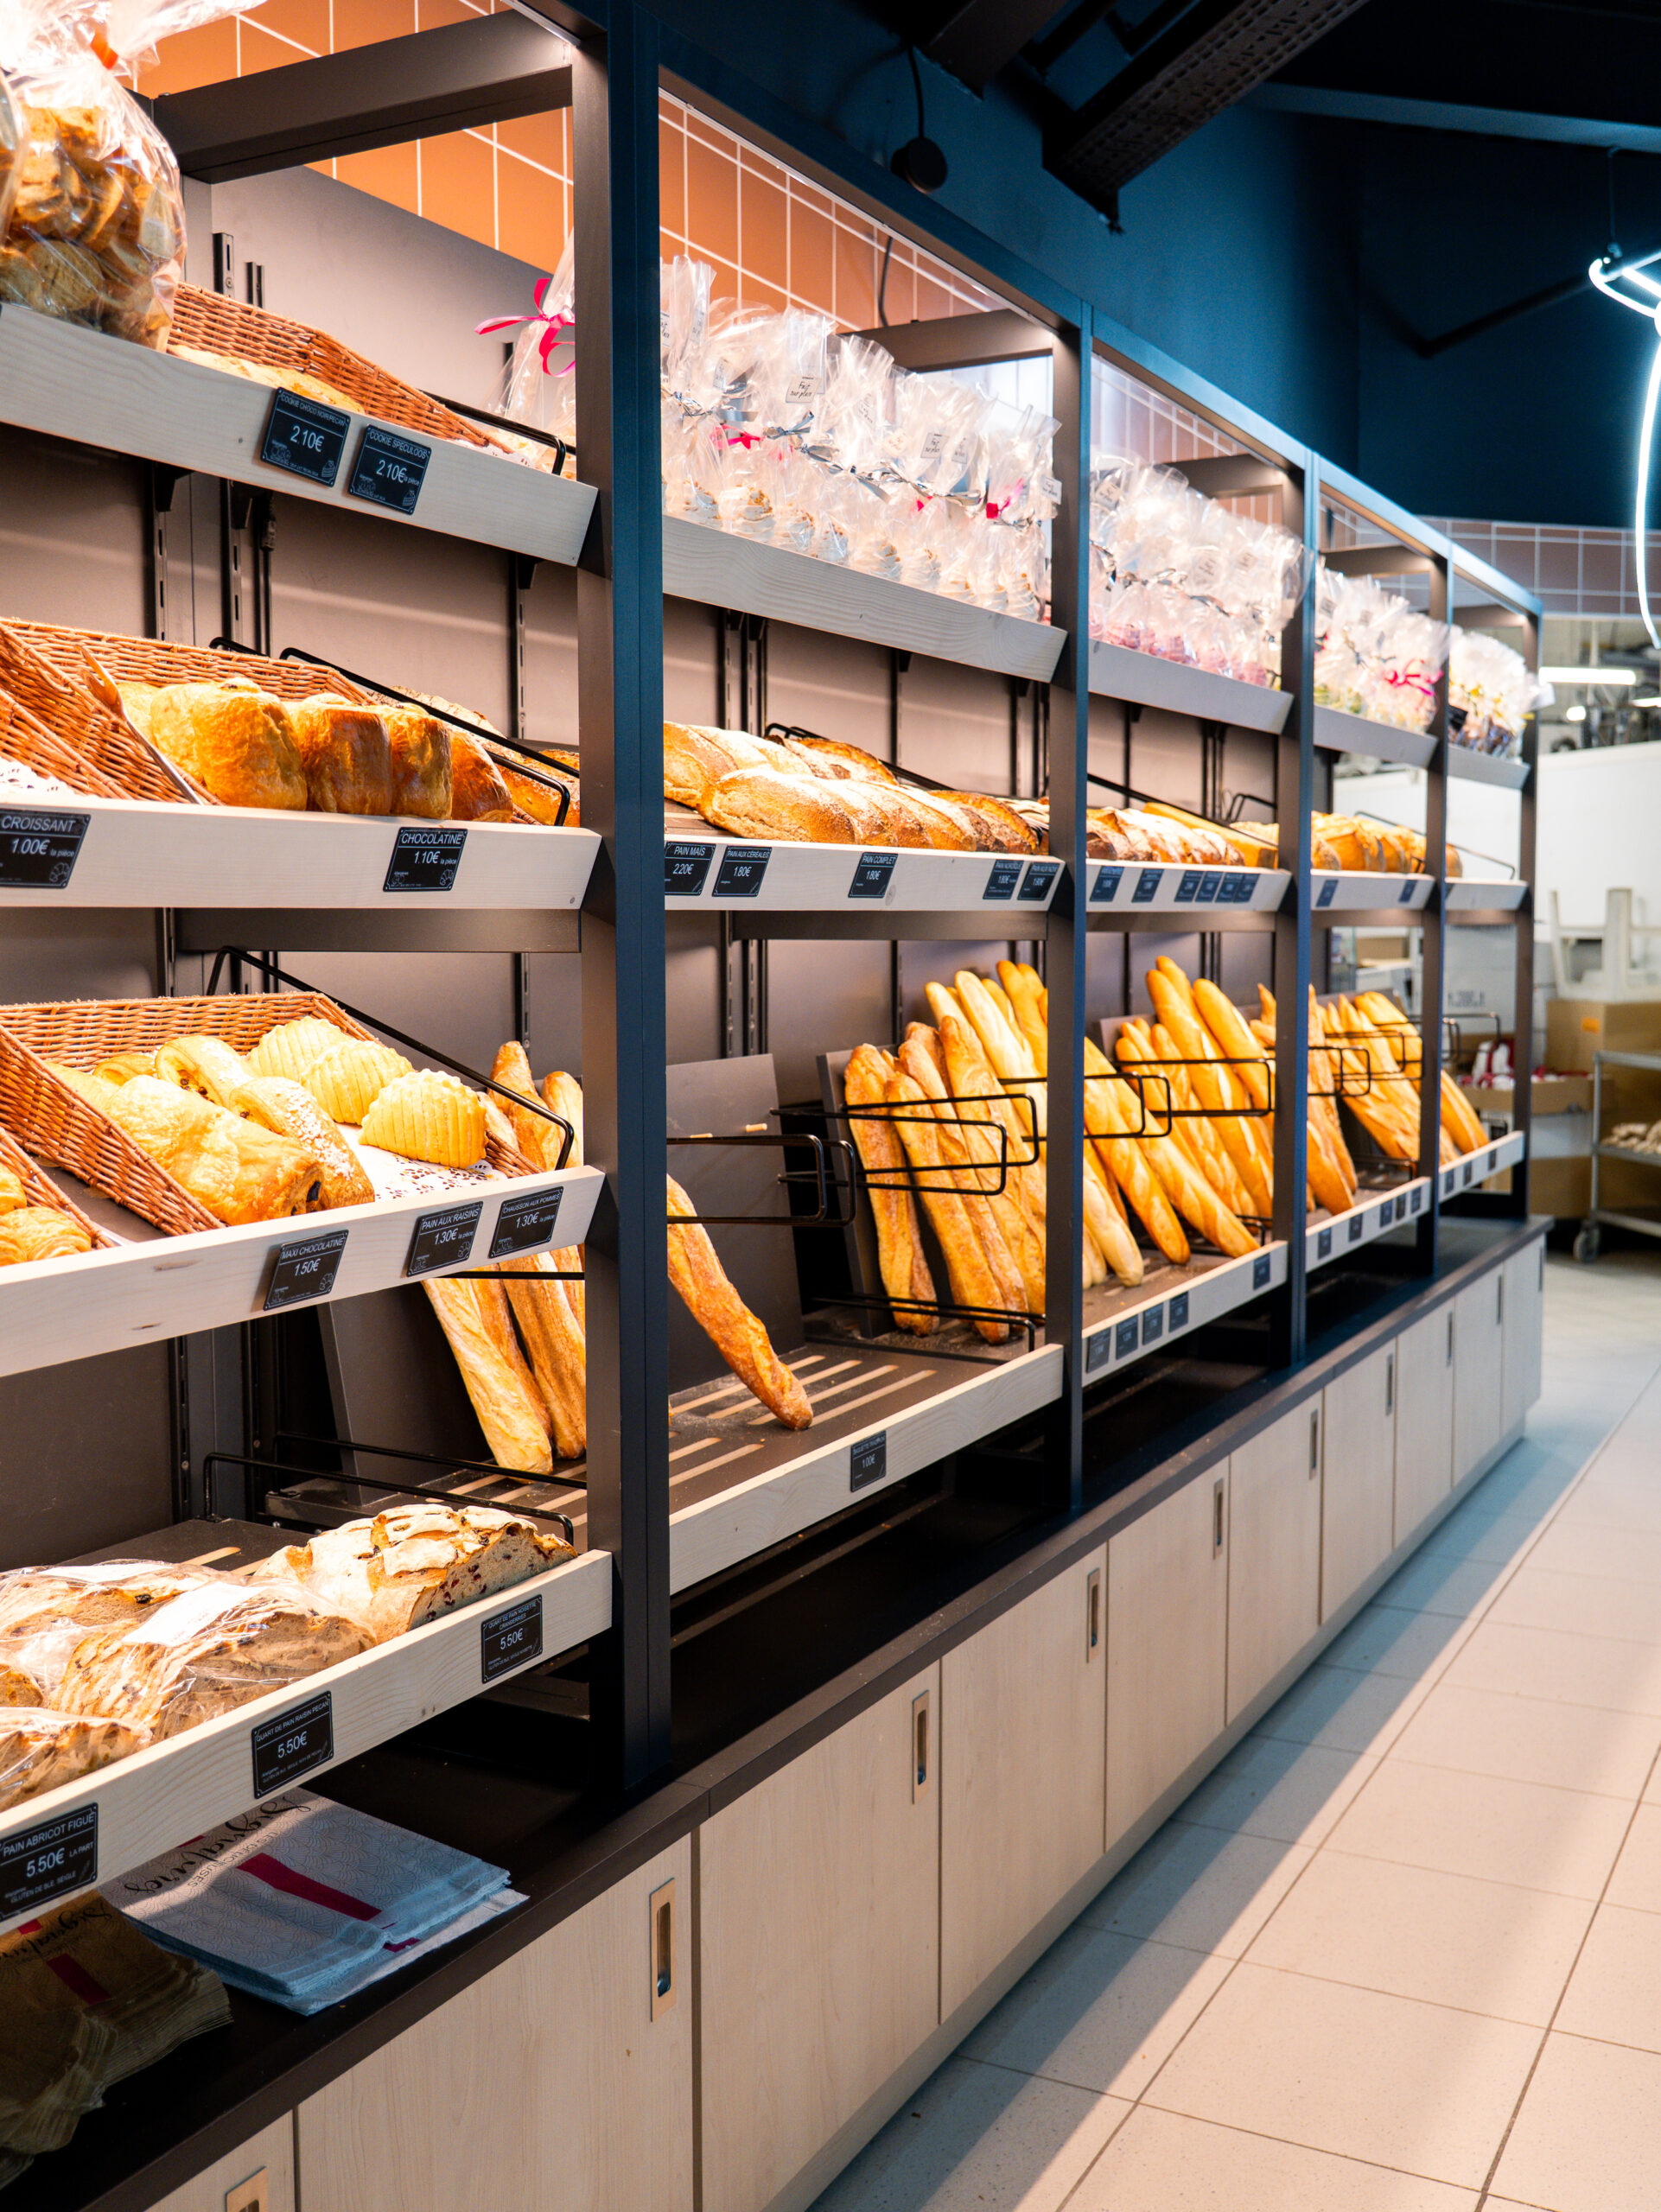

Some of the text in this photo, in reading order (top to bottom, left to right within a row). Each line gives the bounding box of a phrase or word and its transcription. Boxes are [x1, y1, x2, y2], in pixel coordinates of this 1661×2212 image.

[370, 431, 427, 459] COOKIE SPECULOOS
[2, 815, 76, 832] CROISSANT
[401, 833, 461, 844] CHOCOLATINE
[674, 846, 689, 855] PAIN
[422, 1208, 479, 1230] PAIN AUX RAISINS
[281, 1238, 344, 1260] MAXI CHOCOLATINE
[256, 1728, 274, 1742] QUART
[275, 1725, 283, 1734] DE
[283, 1717, 295, 1729] PAIN
[3, 1813, 94, 1857] PAIN ABRICOT FIGUE
